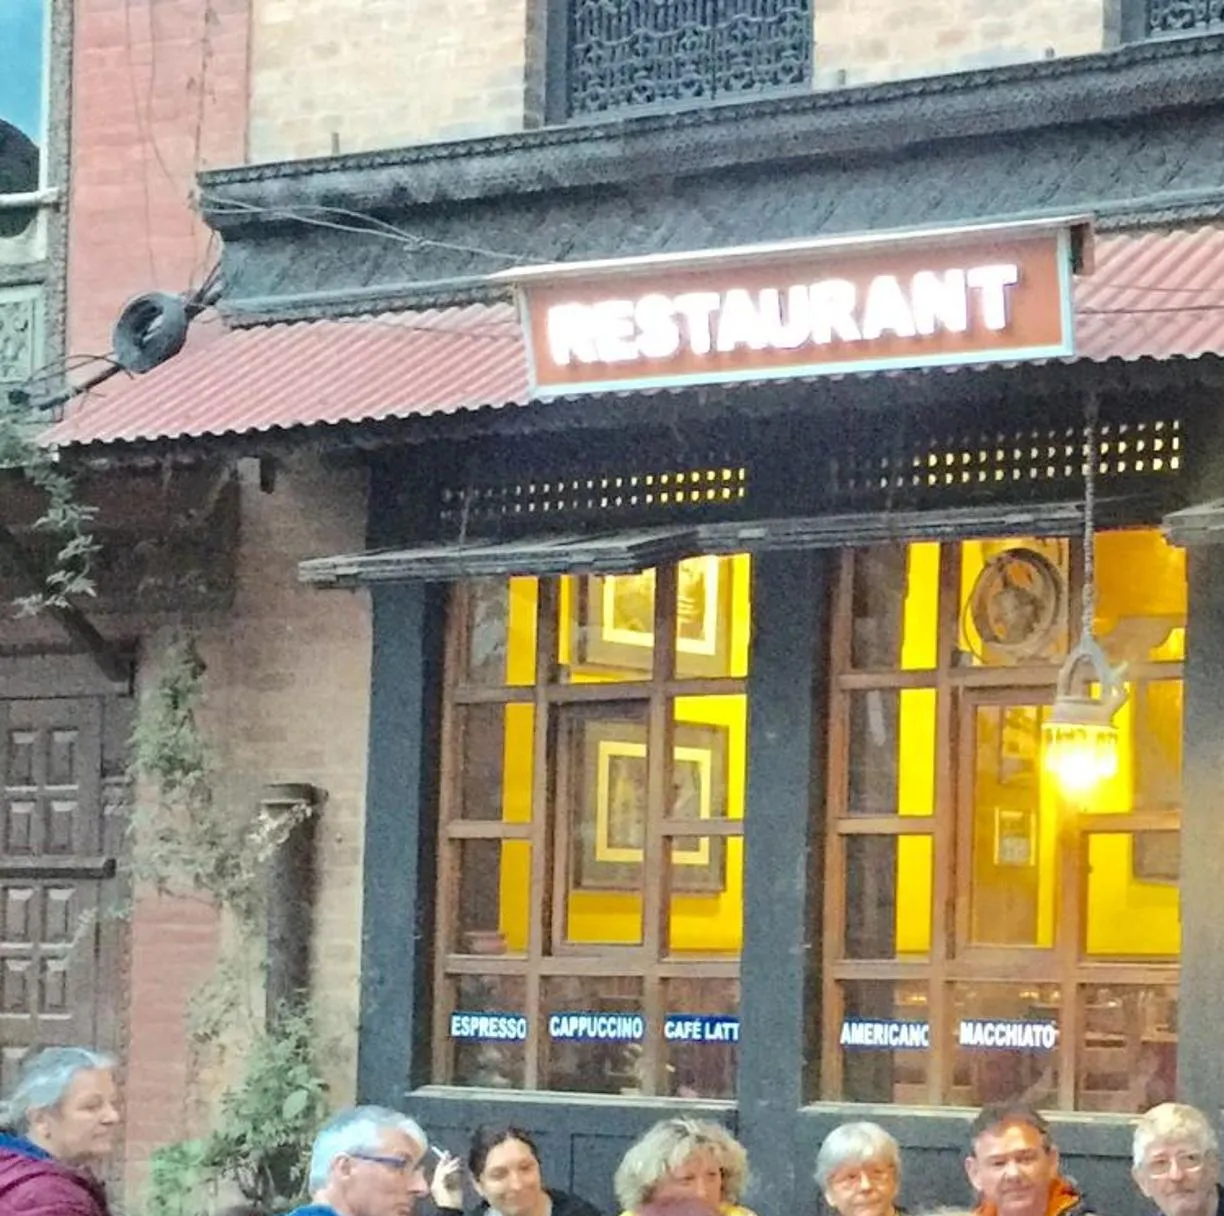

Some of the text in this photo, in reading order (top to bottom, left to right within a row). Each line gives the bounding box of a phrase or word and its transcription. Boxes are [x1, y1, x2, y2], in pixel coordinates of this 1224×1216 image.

[546, 262, 1019, 367] RESTAURANT
[451, 1014, 527, 1040] ESPRESSO
[549, 1014, 644, 1039] CAPPUCCINO
[959, 1019, 1057, 1049] MACCHIATO
